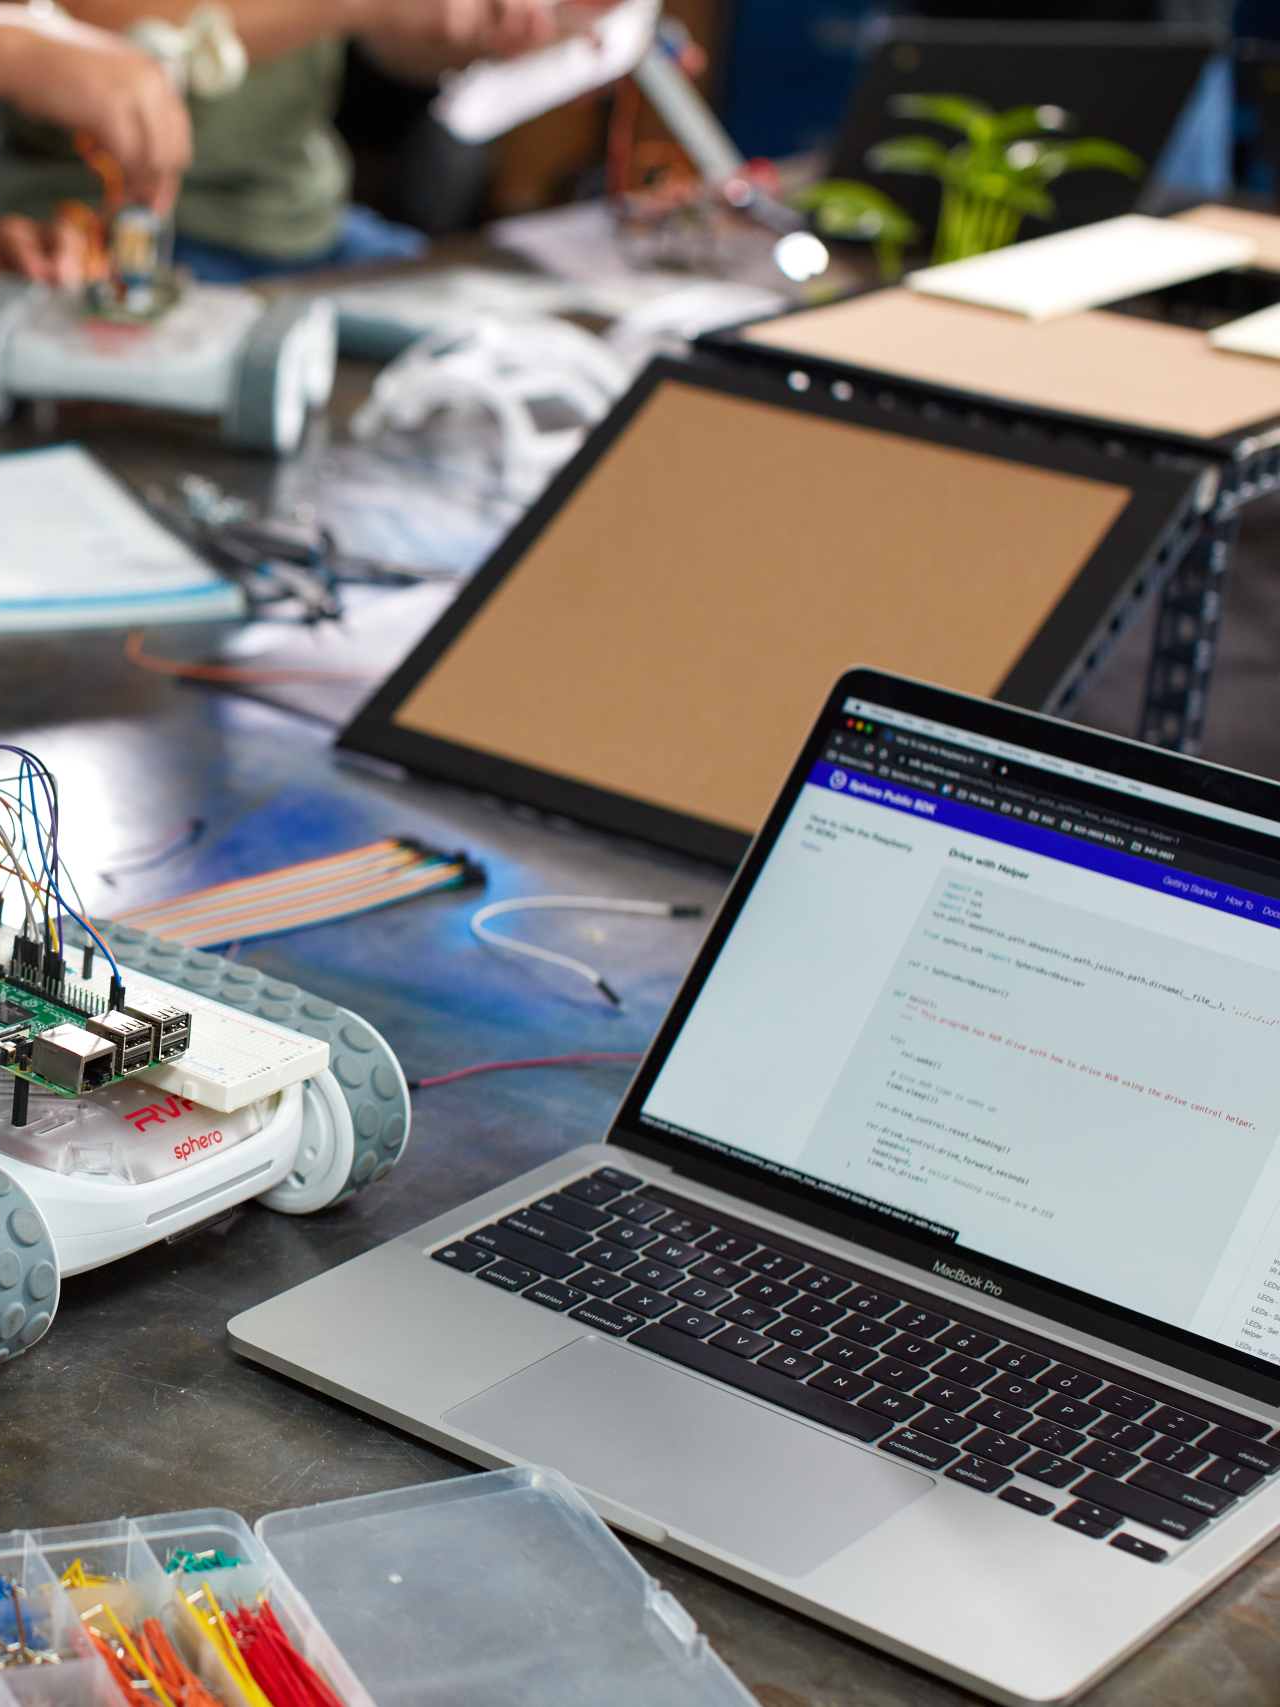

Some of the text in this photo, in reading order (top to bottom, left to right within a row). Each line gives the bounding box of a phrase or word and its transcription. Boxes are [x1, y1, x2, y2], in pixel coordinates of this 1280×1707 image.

[848, 779, 937, 814] Sphero Public SDK
[948, 848, 1030, 879] Drive with Helper
[1162, 876, 1218, 899] Getting Started
[1225, 895, 1254, 911] How To
[939, 1017, 970, 1032] program
[1004, 1039, 1026, 1051] drive
[1029, 1048, 1047, 1058] with
[1050, 1054, 1064, 1064] how
[1067, 1060, 1076, 1069] to
[1079, 1064, 1102, 1077] drive
[1104, 1073, 1119, 1082] RVR
[1121, 1080, 1144, 1093] using
[1148, 1087, 1161, 1097] the
[1164, 1094, 1188, 1106] drive
[1190, 1103, 1222, 1118] control
[1225, 1114, 1256, 1130] helper.
[174, 1130, 223, 1161] sphero
[1014, 1201, 1029, 1210] are
[474, 1232, 497, 1247] shift
[620, 1230, 634, 1239] Q
[600, 1251, 612, 1260] A
[666, 1247, 682, 1257] W
[485, 1268, 518, 1287] control
[647, 1270, 660, 1278] S
[932, 1259, 1003, 1296] MacBook Pro
[591, 1277, 606, 1286] Z
[1263, 1280, 1280, 1291] LEDs
[693, 1289, 707, 1297] D
[759, 1286, 773, 1295] R
[533, 1289, 564, 1307] option
[638, 1296, 653, 1305] X
[1257, 1292, 1274, 1304] LEDs
[810, 1305, 822, 1313] T
[858, 1300, 870, 1308] 6
[1251, 1305, 1268, 1317] LEDs
[578, 1309, 624, 1332] command
[686, 1317, 700, 1325] C
[859, 1324, 871, 1333] Y
[1245, 1318, 1279, 1336] LEDs Set
[790, 1328, 803, 1337] G
[1241, 1327, 1262, 1340] Helper
[736, 1336, 749, 1345] V
[957, 1339, 969, 1347] 8
[838, 1348, 854, 1357] H
[907, 1344, 921, 1353] U
[1235, 1340, 1252, 1352] LEDs
[1257, 1348, 1269, 1358] Set
[783, 1357, 797, 1365] B
[1008, 1359, 1020, 1367] 9
[833, 1377, 848, 1387] N
[940, 1389, 954, 1398] K
[883, 1398, 900, 1408] M
[993, 1410, 1002, 1419] L
[888, 1439, 938, 1464] command
[954, 1466, 988, 1485] option
